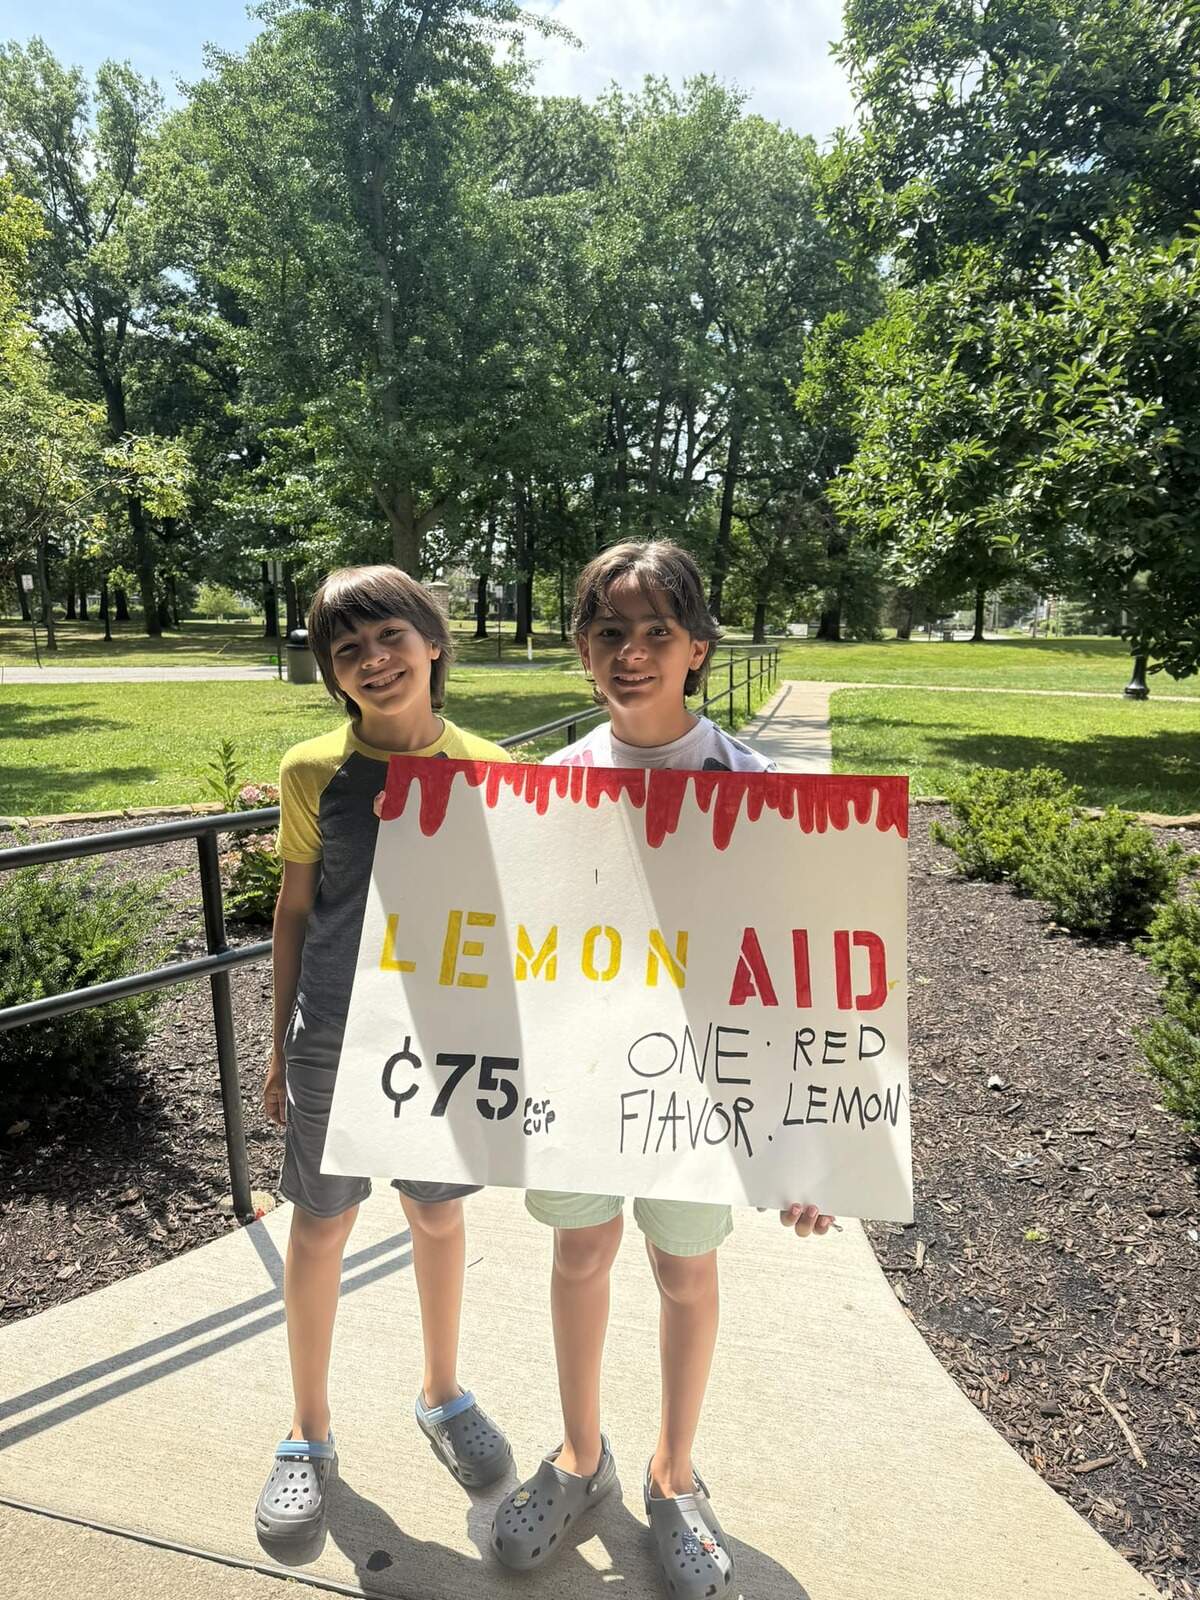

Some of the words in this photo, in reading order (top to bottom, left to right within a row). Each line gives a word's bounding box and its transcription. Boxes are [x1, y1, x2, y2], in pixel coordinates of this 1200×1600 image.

[380, 910, 689, 988] LEMON
[729, 927, 889, 1011] AID
[793, 1024, 886, 1071] RED
[782, 1082, 901, 1130] LEMON
